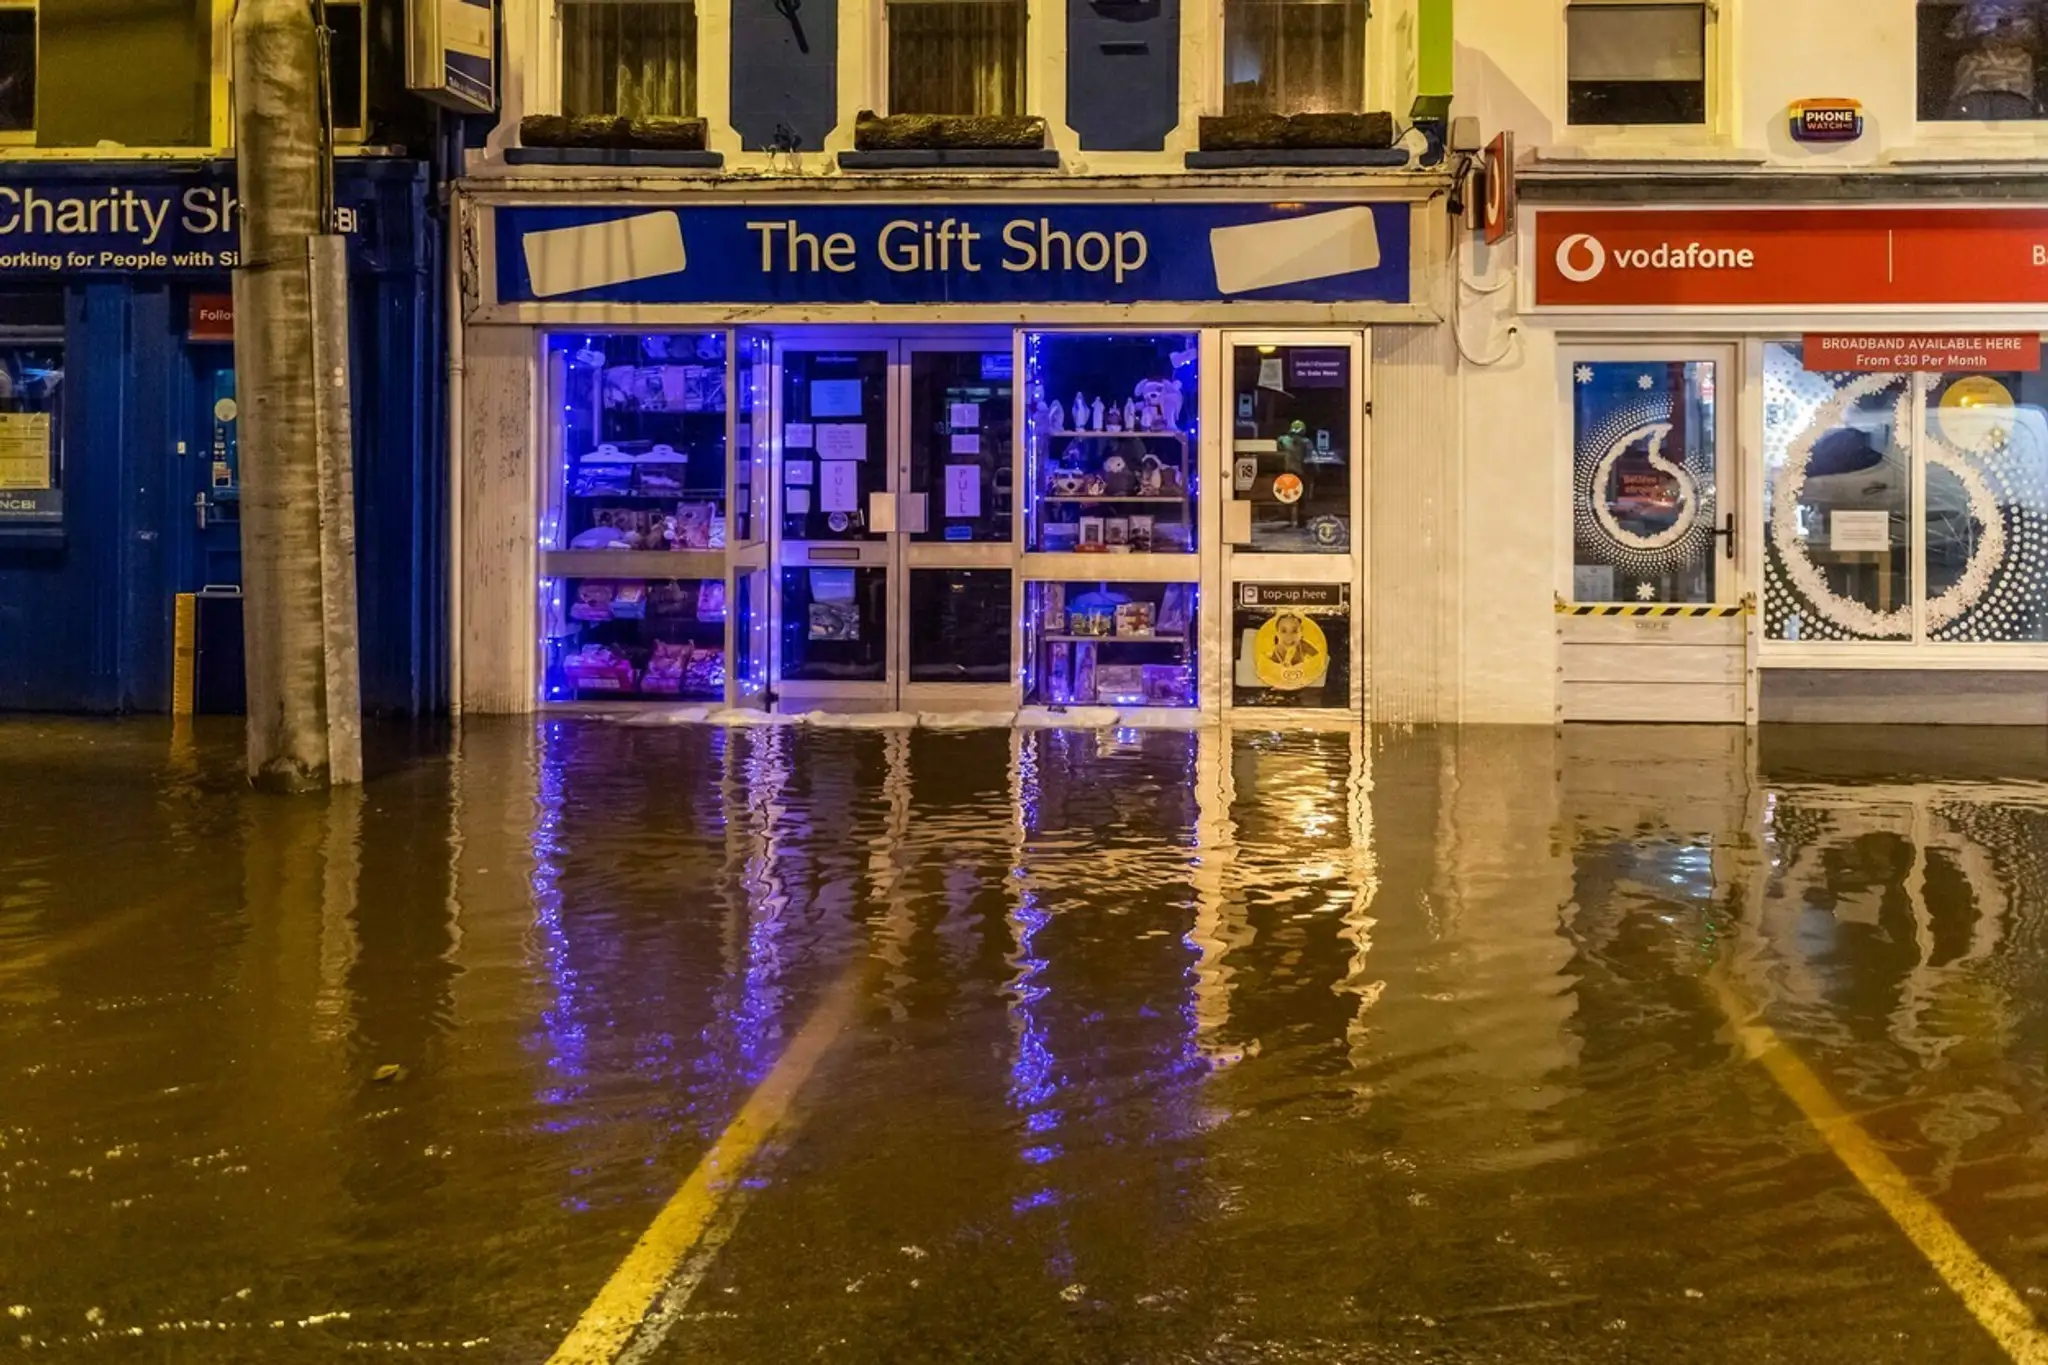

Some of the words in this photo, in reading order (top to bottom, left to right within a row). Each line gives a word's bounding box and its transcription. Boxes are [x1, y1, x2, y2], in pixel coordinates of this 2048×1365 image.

[1805, 111, 1853, 122] PHONE
[1807, 122, 1843, 130] WATCH
[334, 206, 357, 232] BI
[746, 219, 857, 272] The
[877, 217, 981, 272] Gift
[1001, 217, 1148, 284] Shop
[1613, 242, 1755, 269] vodafone
[67, 251, 94, 267] for
[100, 251, 167, 270] People
[172, 251, 214, 267] with
[199, 309, 233, 321] Follo
[1822, 337, 1905, 350] BROADBAND
[1908, 337, 1982, 350] AVAILABLE
[1985, 337, 2022, 350] HERE
[1856, 355, 1890, 366] From
[1894, 354, 1918, 366] €30
[1922, 355, 1943, 366] Per
[1948, 354, 1987, 366] Month
[957, 469, 969, 514] PULL
[1263, 588, 1300, 600] top-up
[1302, 589, 1328, 600] here
